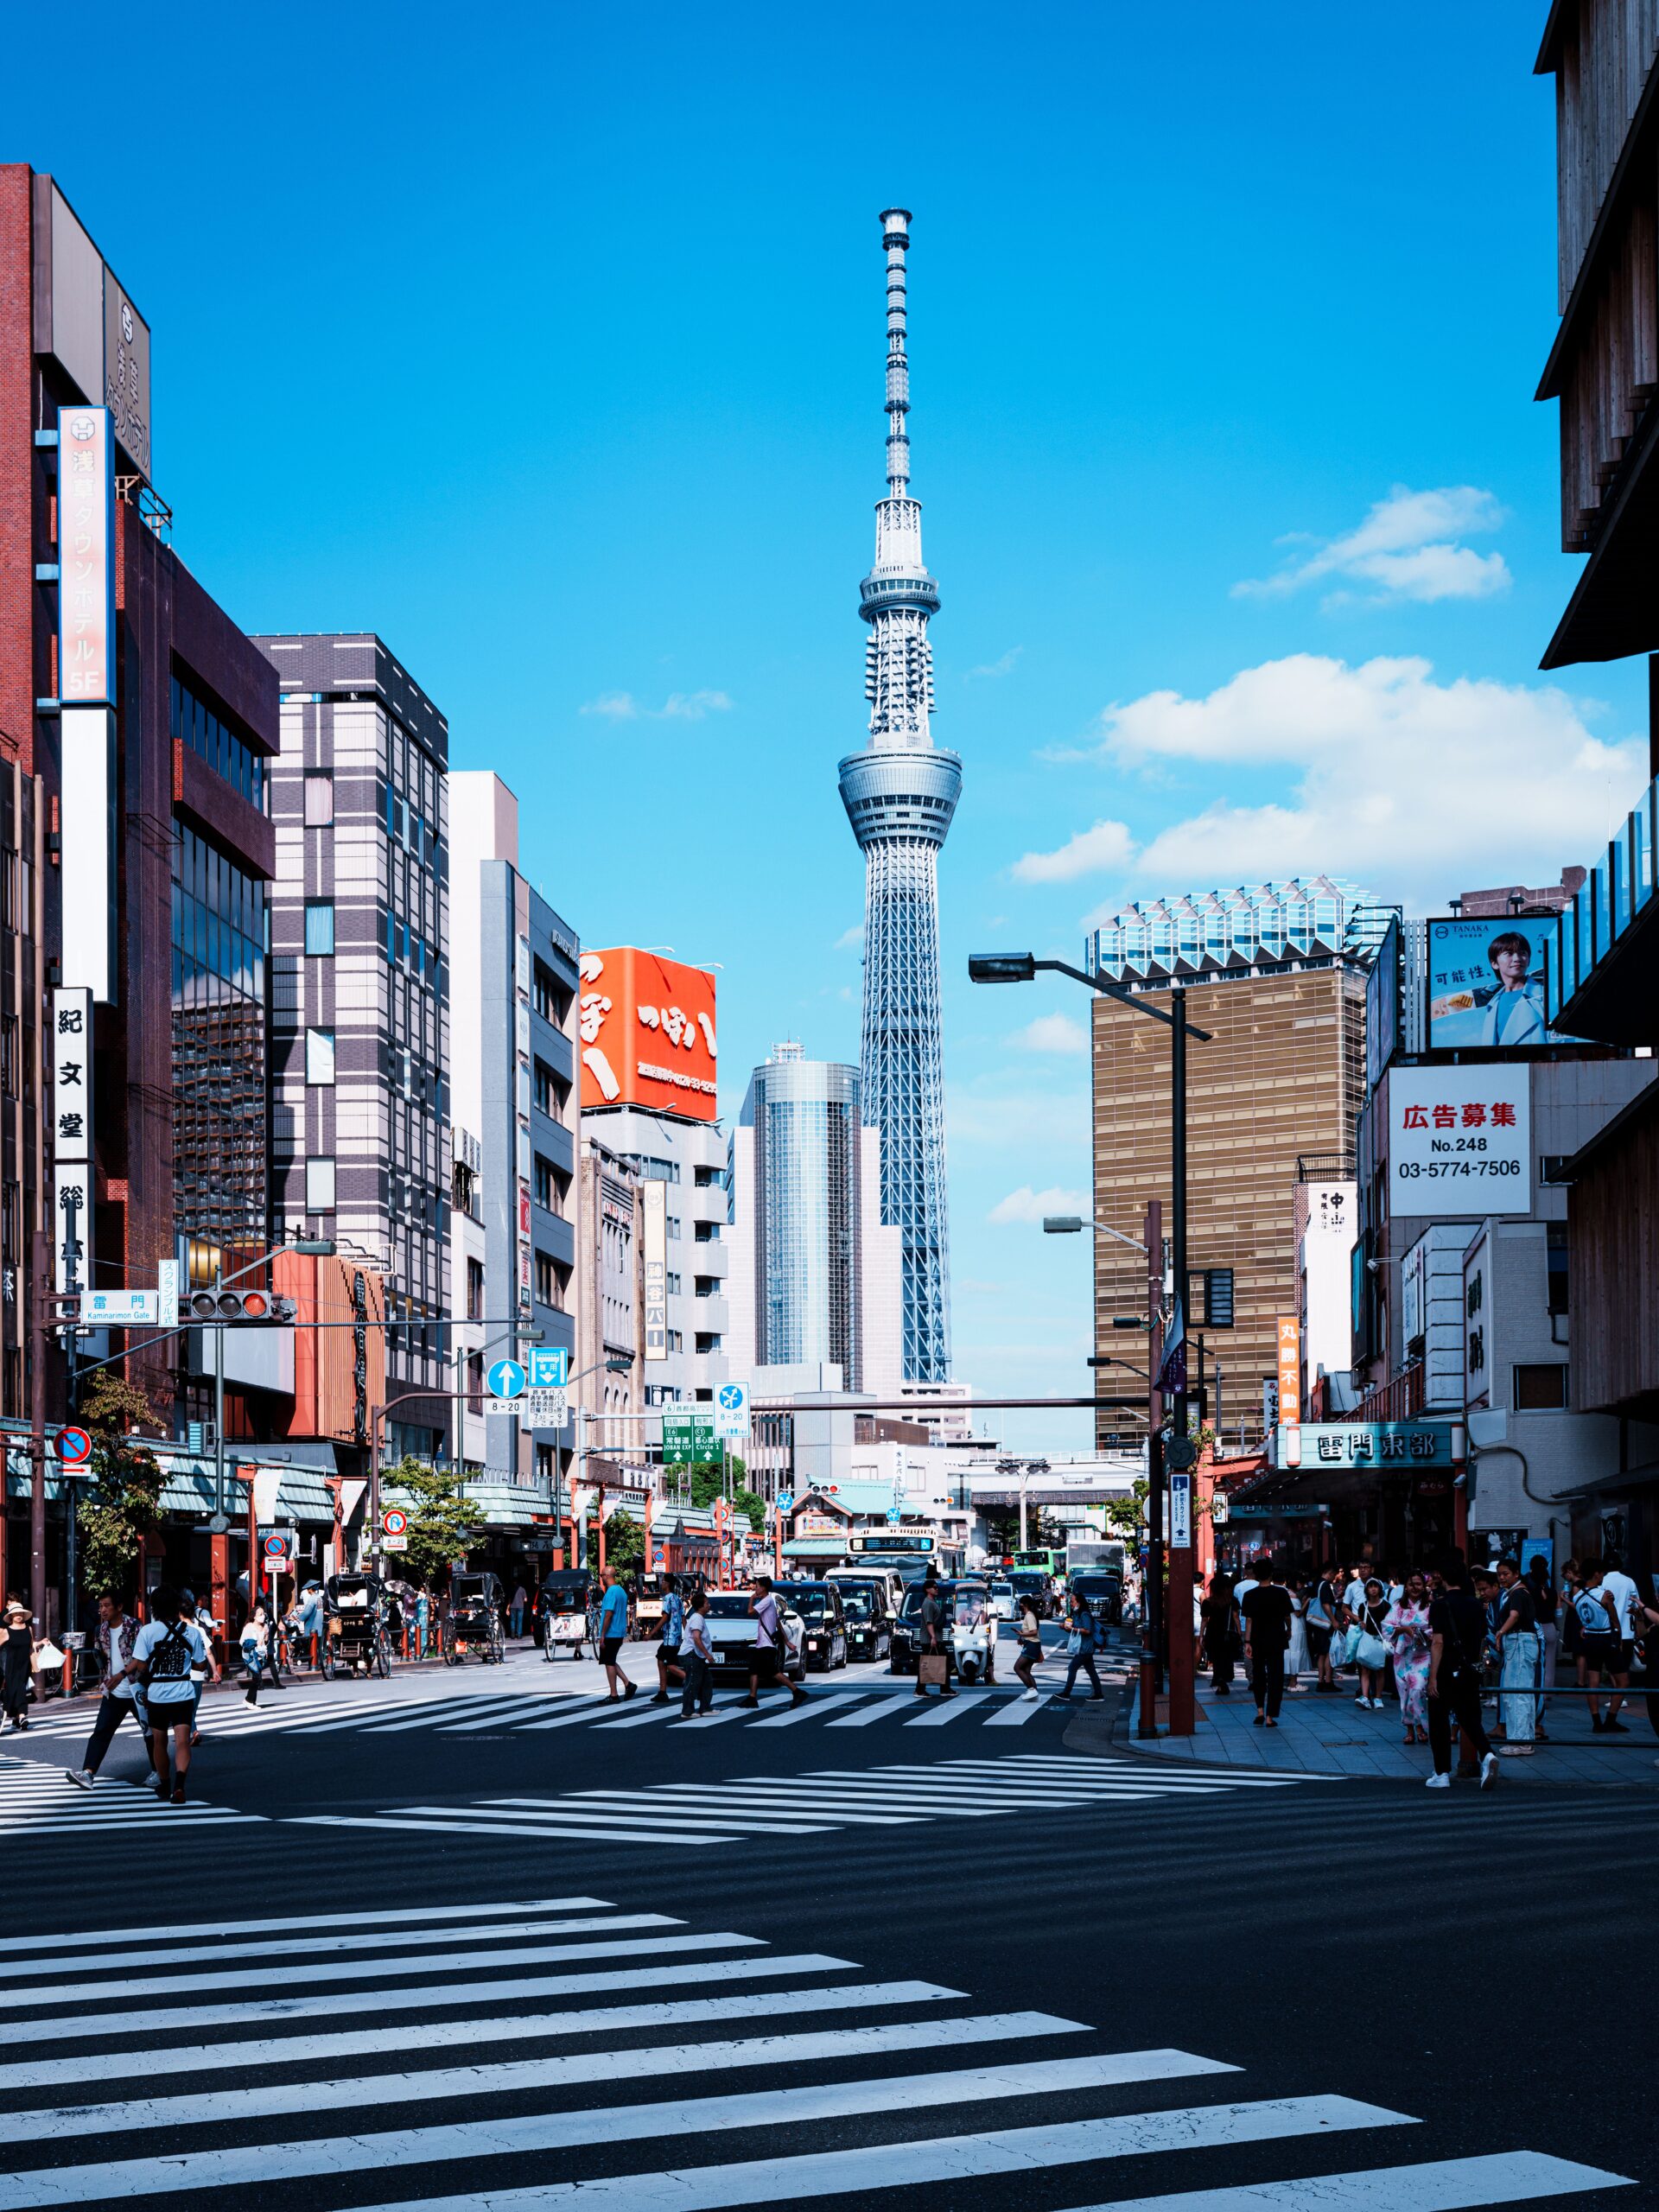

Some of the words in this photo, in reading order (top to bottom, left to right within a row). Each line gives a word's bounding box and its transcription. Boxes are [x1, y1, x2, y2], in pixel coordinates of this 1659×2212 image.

[71, 449, 95, 663] 浅草タウンホテル
[69, 671, 99, 692] 5F
[58, 1008, 84, 1139] 紀文堂
[1402, 1102, 1516, 1129] 広告募集
[1431, 1137, 1487, 1152] No.248
[1399, 1160, 1521, 1179] 03-5774-7506
[92, 1294, 145, 1310] 雷門
[647, 1262, 664, 1347] 神谷バー
[133, 1311, 150, 1319] Gate
[1318, 1432, 1436, 1461] 雷門東部
